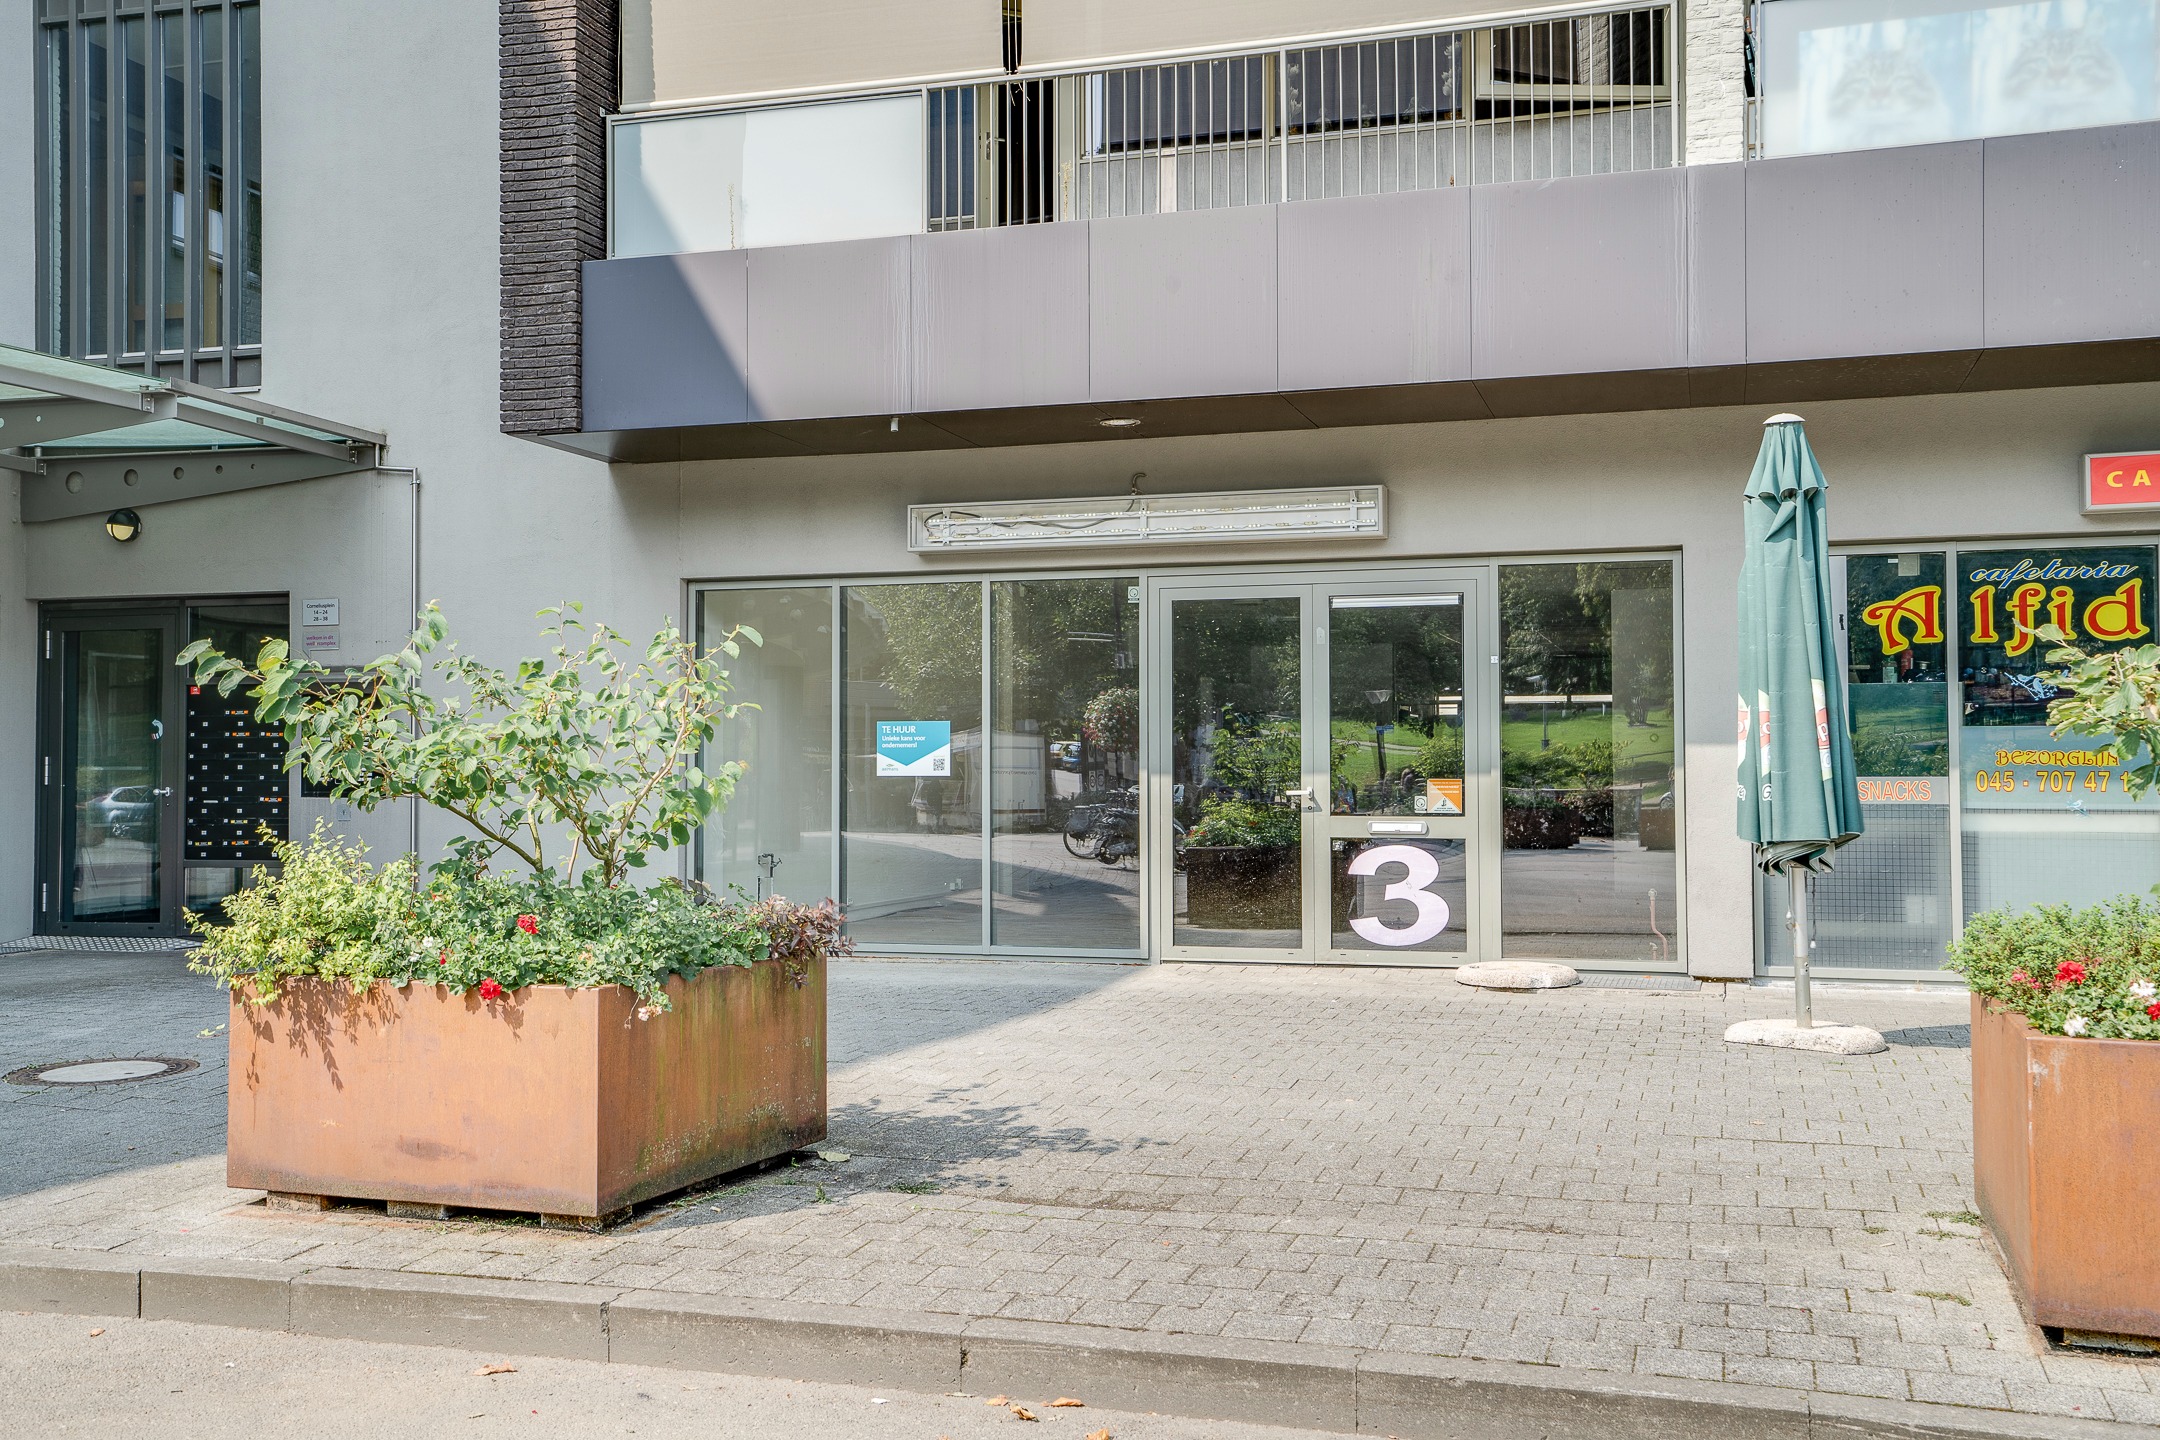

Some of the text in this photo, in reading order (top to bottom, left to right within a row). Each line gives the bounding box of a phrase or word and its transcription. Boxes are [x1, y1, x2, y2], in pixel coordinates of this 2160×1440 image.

[1969, 558, 2138, 590] cafetaria
[1862, 578, 2150, 657] Alfid
[893, 726, 916, 734] HUUR
[1857, 780, 1932, 802] SNACKS
[1975, 770, 2015, 793] 045
[2036, 770, 2076, 793] 707
[2083, 770, 2111, 793] 47
[1347, 844, 1450, 947] 3
